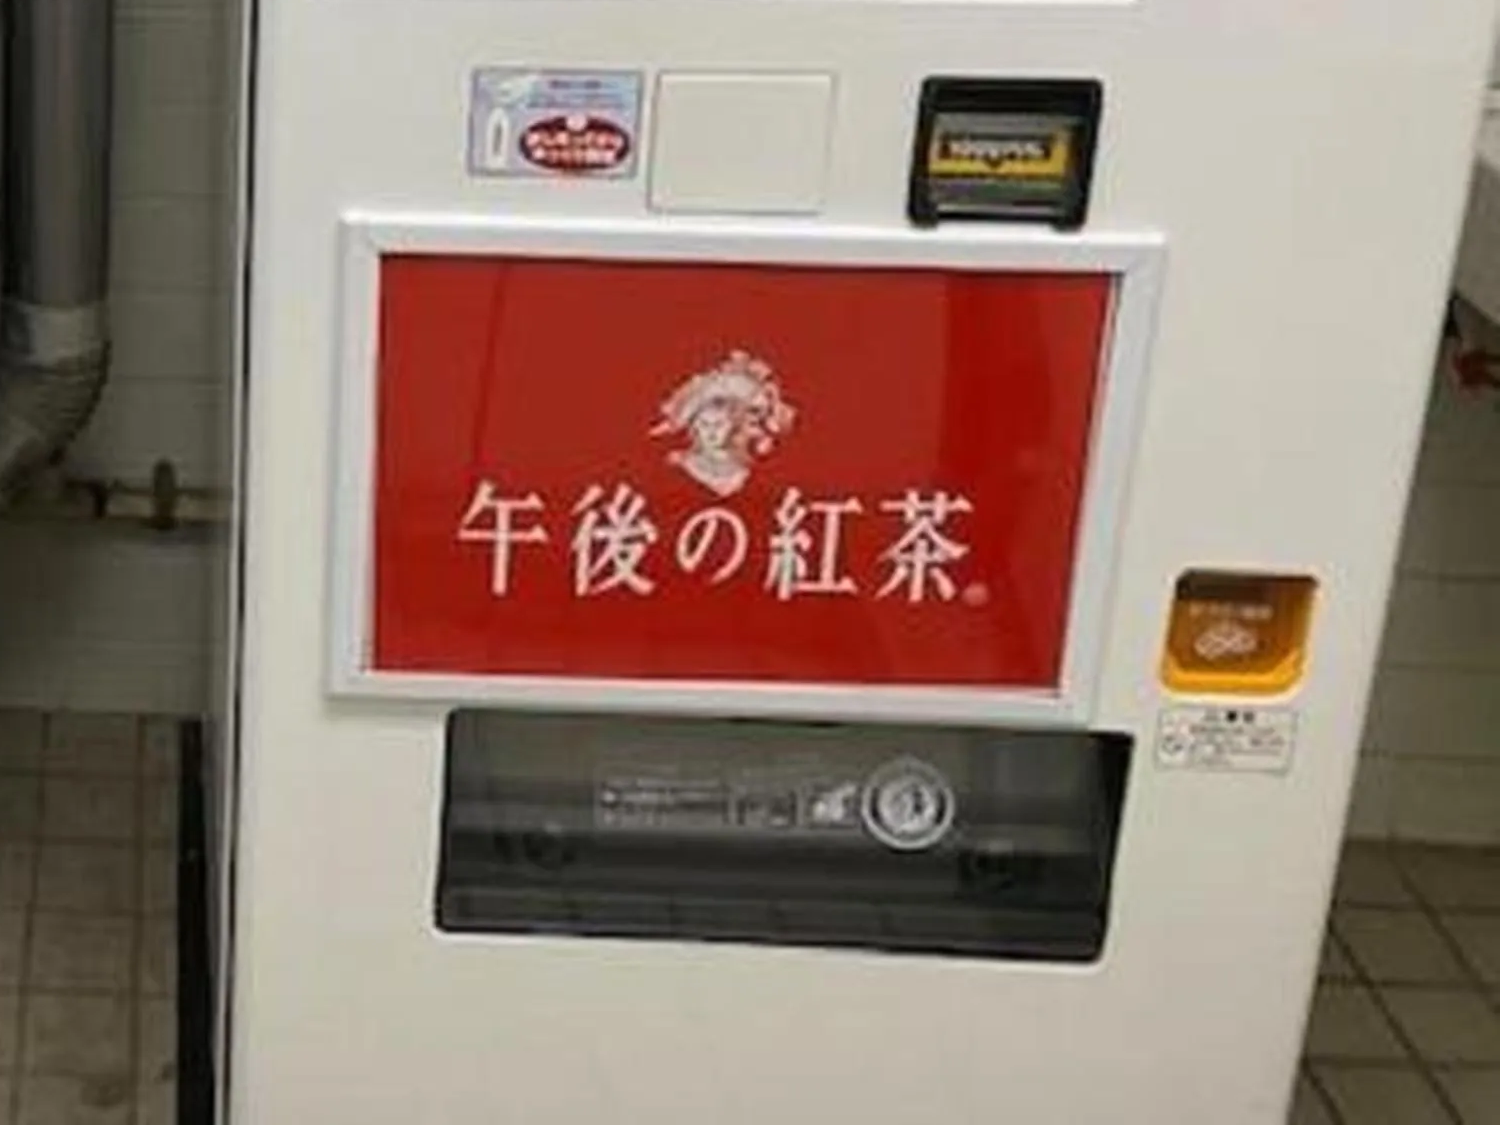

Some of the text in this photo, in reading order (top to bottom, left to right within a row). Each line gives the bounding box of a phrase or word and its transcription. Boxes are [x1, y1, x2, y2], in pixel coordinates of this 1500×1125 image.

[457, 479, 975, 602] 午後の紅茶
